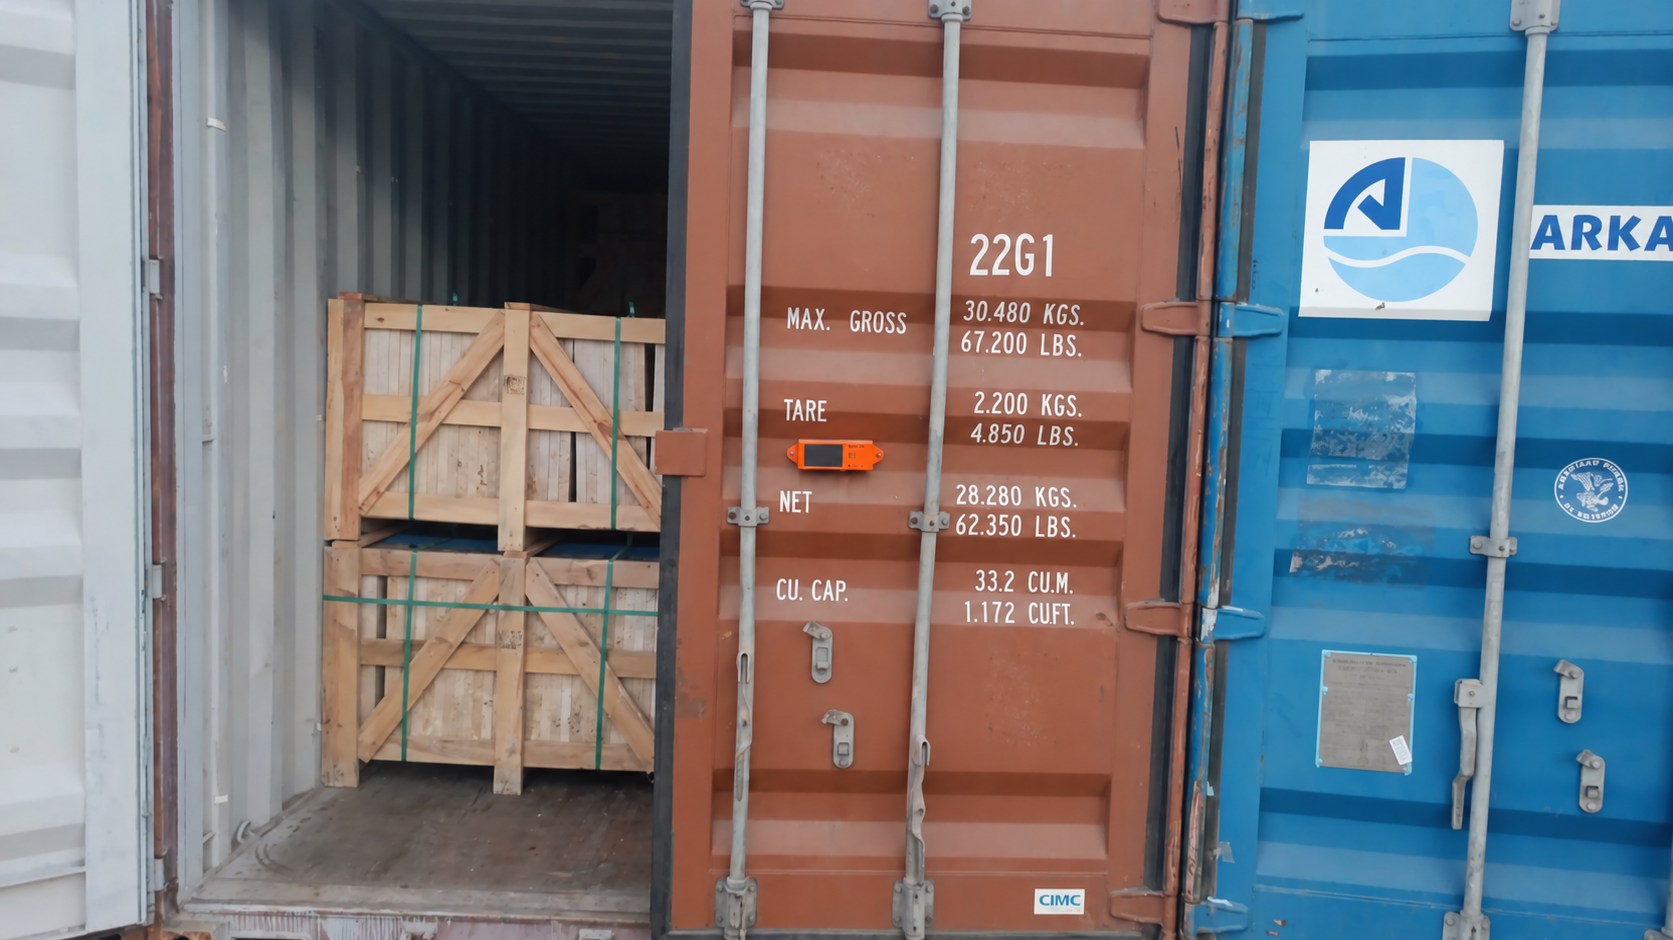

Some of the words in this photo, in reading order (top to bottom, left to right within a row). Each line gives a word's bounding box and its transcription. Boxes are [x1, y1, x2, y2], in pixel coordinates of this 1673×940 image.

[970, 233, 1053, 276] 22G1
[787, 307, 830, 331] MAX.
[849, 310, 907, 334] GROSS
[963, 300, 1031, 323] 30.480
[1043, 303, 1084, 326] KGS.
[961, 331, 1027, 355] 67.200
[1040, 334, 1082, 357] LBS.
[784, 399, 828, 421] TARE
[974, 391, 1028, 415] 2.200
[1041, 394, 1082, 417] KGS.
[970, 423, 1025, 444] 4.850
[1037, 425, 1079, 447] LBS.
[779, 490, 813, 513] NET
[956, 484, 1022, 507] 28.280
[1035, 486, 1077, 508] KGS.
[955, 514, 1022, 537] 62.350
[1035, 515, 1076, 538] LBS.
[776, 578, 803, 601] CU.
[811, 579, 848, 602] CAP.
[975, 570, 1015, 593] 33.2
[964, 600, 1016, 624] 1.172
[1039, 894, 1081, 906] CIMC
